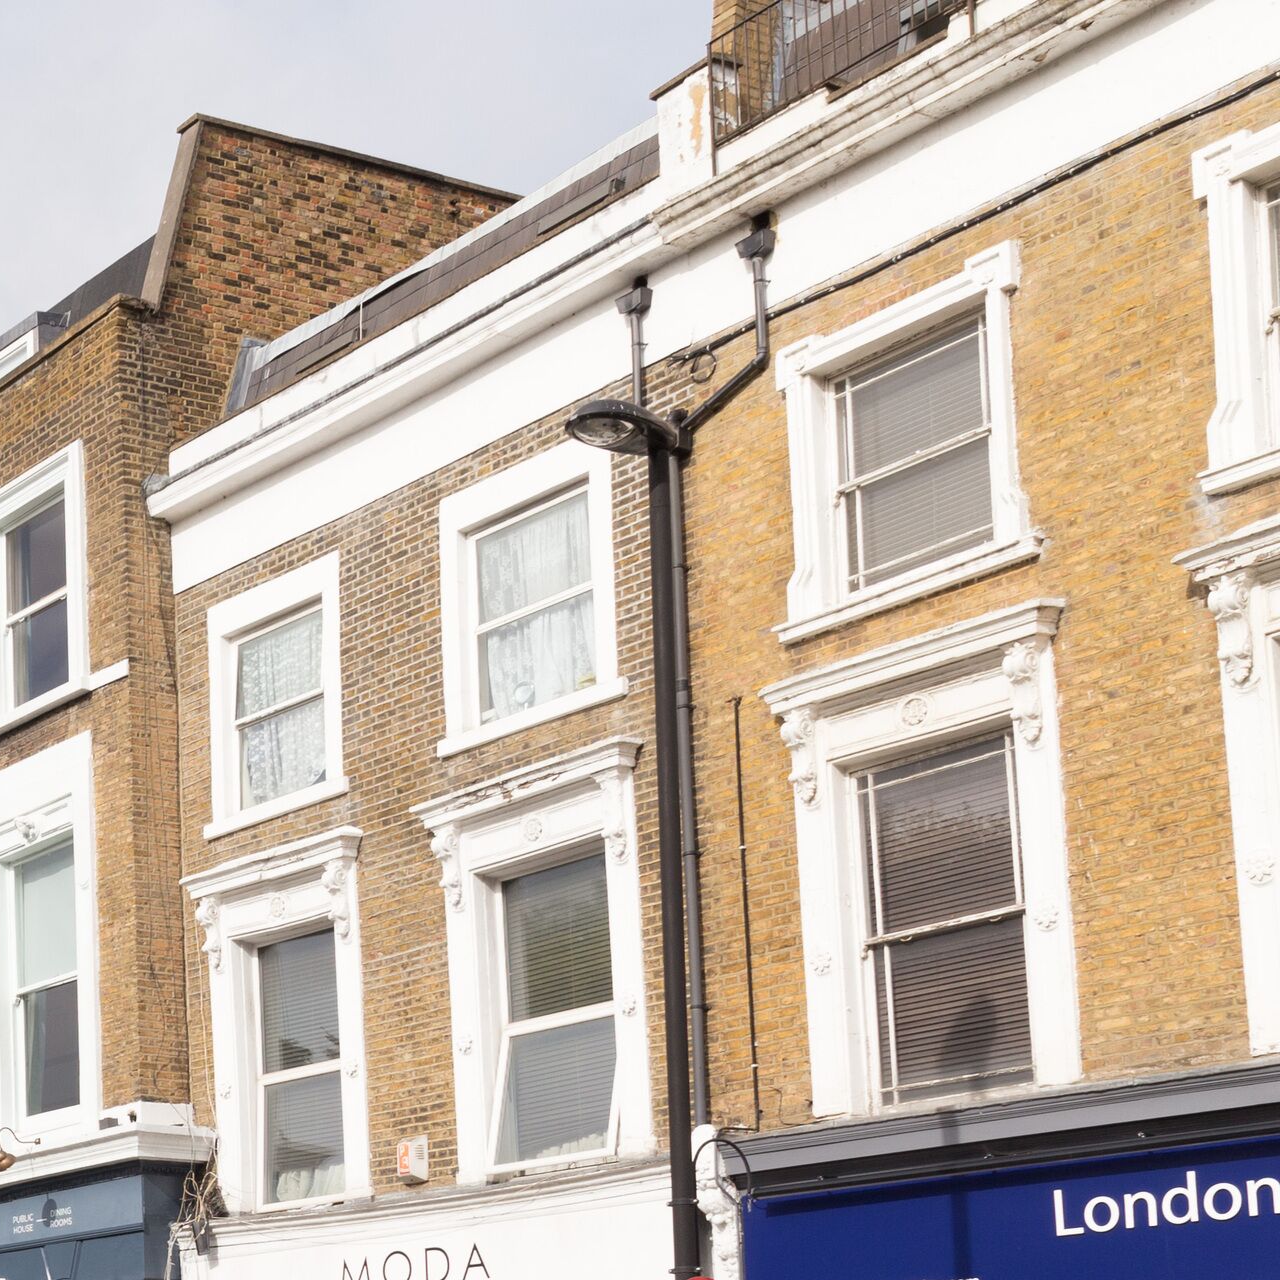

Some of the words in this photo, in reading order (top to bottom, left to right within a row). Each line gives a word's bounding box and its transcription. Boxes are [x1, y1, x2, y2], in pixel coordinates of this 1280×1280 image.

[1053, 1170, 1280, 1237] London
[50, 1206, 72, 1218] DINING
[12, 1213, 34, 1224] PUBLIC
[50, 1217, 73, 1228] ROOMS
[13, 1224, 34, 1234] HOUSE
